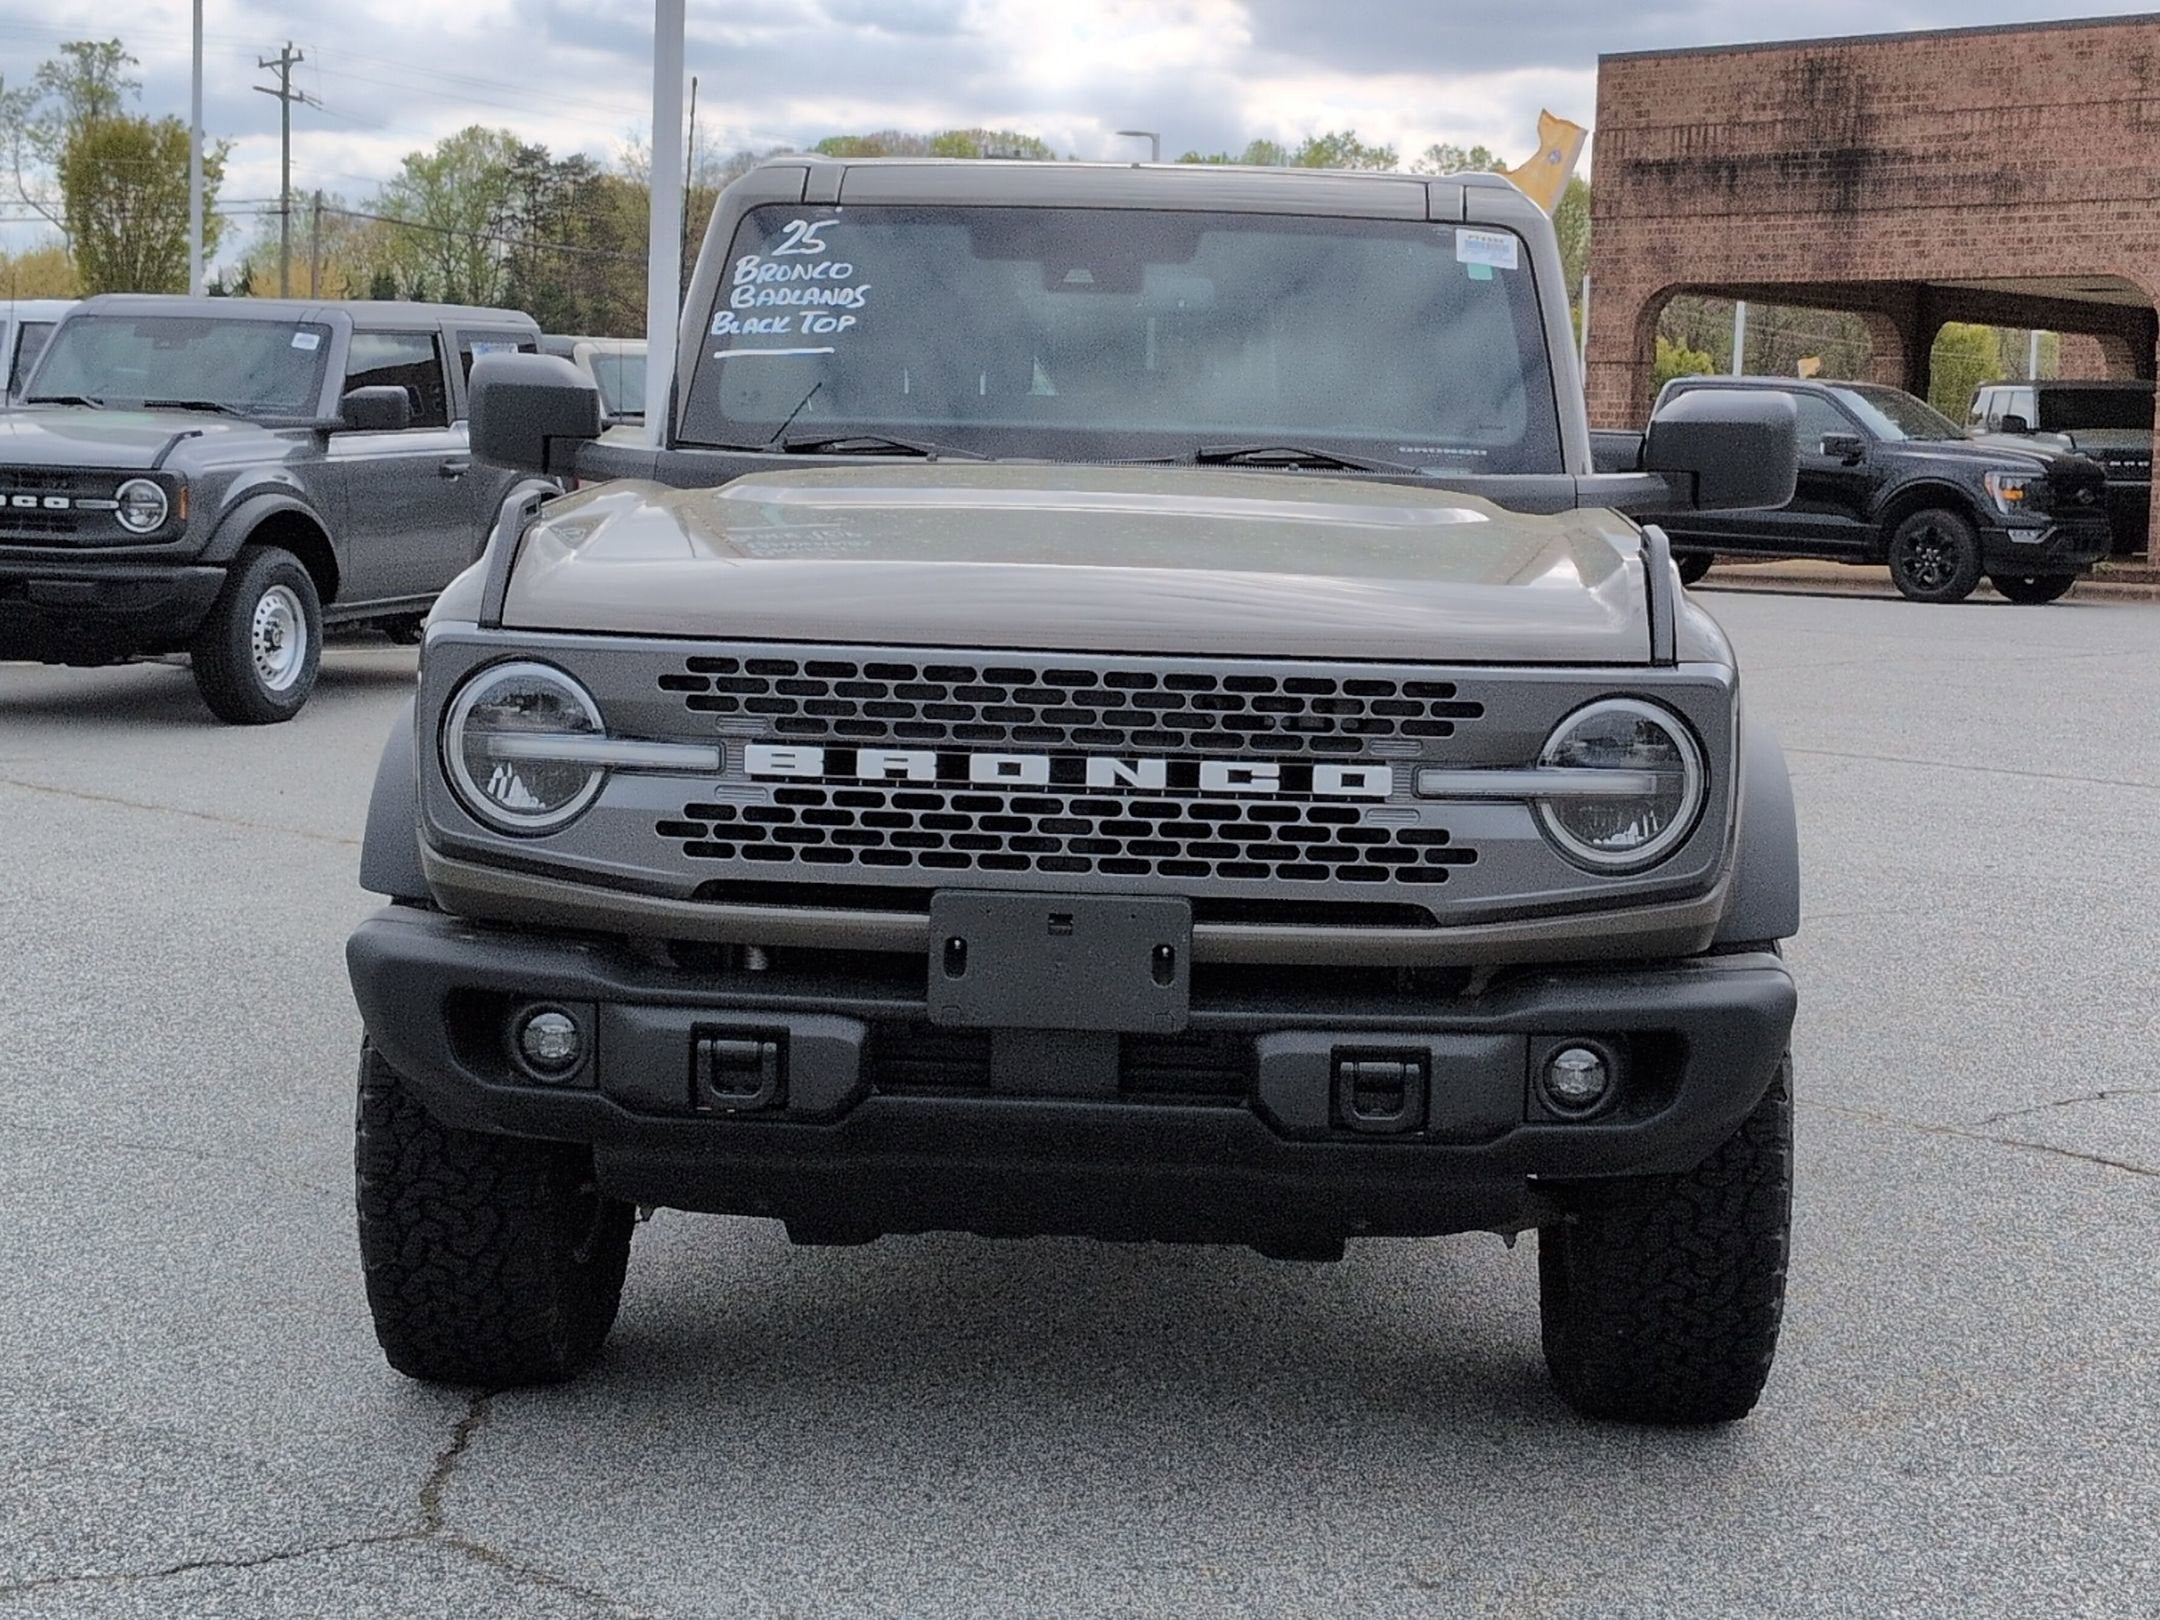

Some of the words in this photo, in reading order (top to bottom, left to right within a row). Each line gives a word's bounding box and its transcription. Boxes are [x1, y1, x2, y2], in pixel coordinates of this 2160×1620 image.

[772, 218, 840, 256] 25
[733, 255, 853, 285] BRONCO
[730, 284, 871, 309] BADLANDS
[711, 311, 791, 336] BLACK
[800, 310, 857, 334] TOP
[744, 744, 1392, 798] BRONCO
